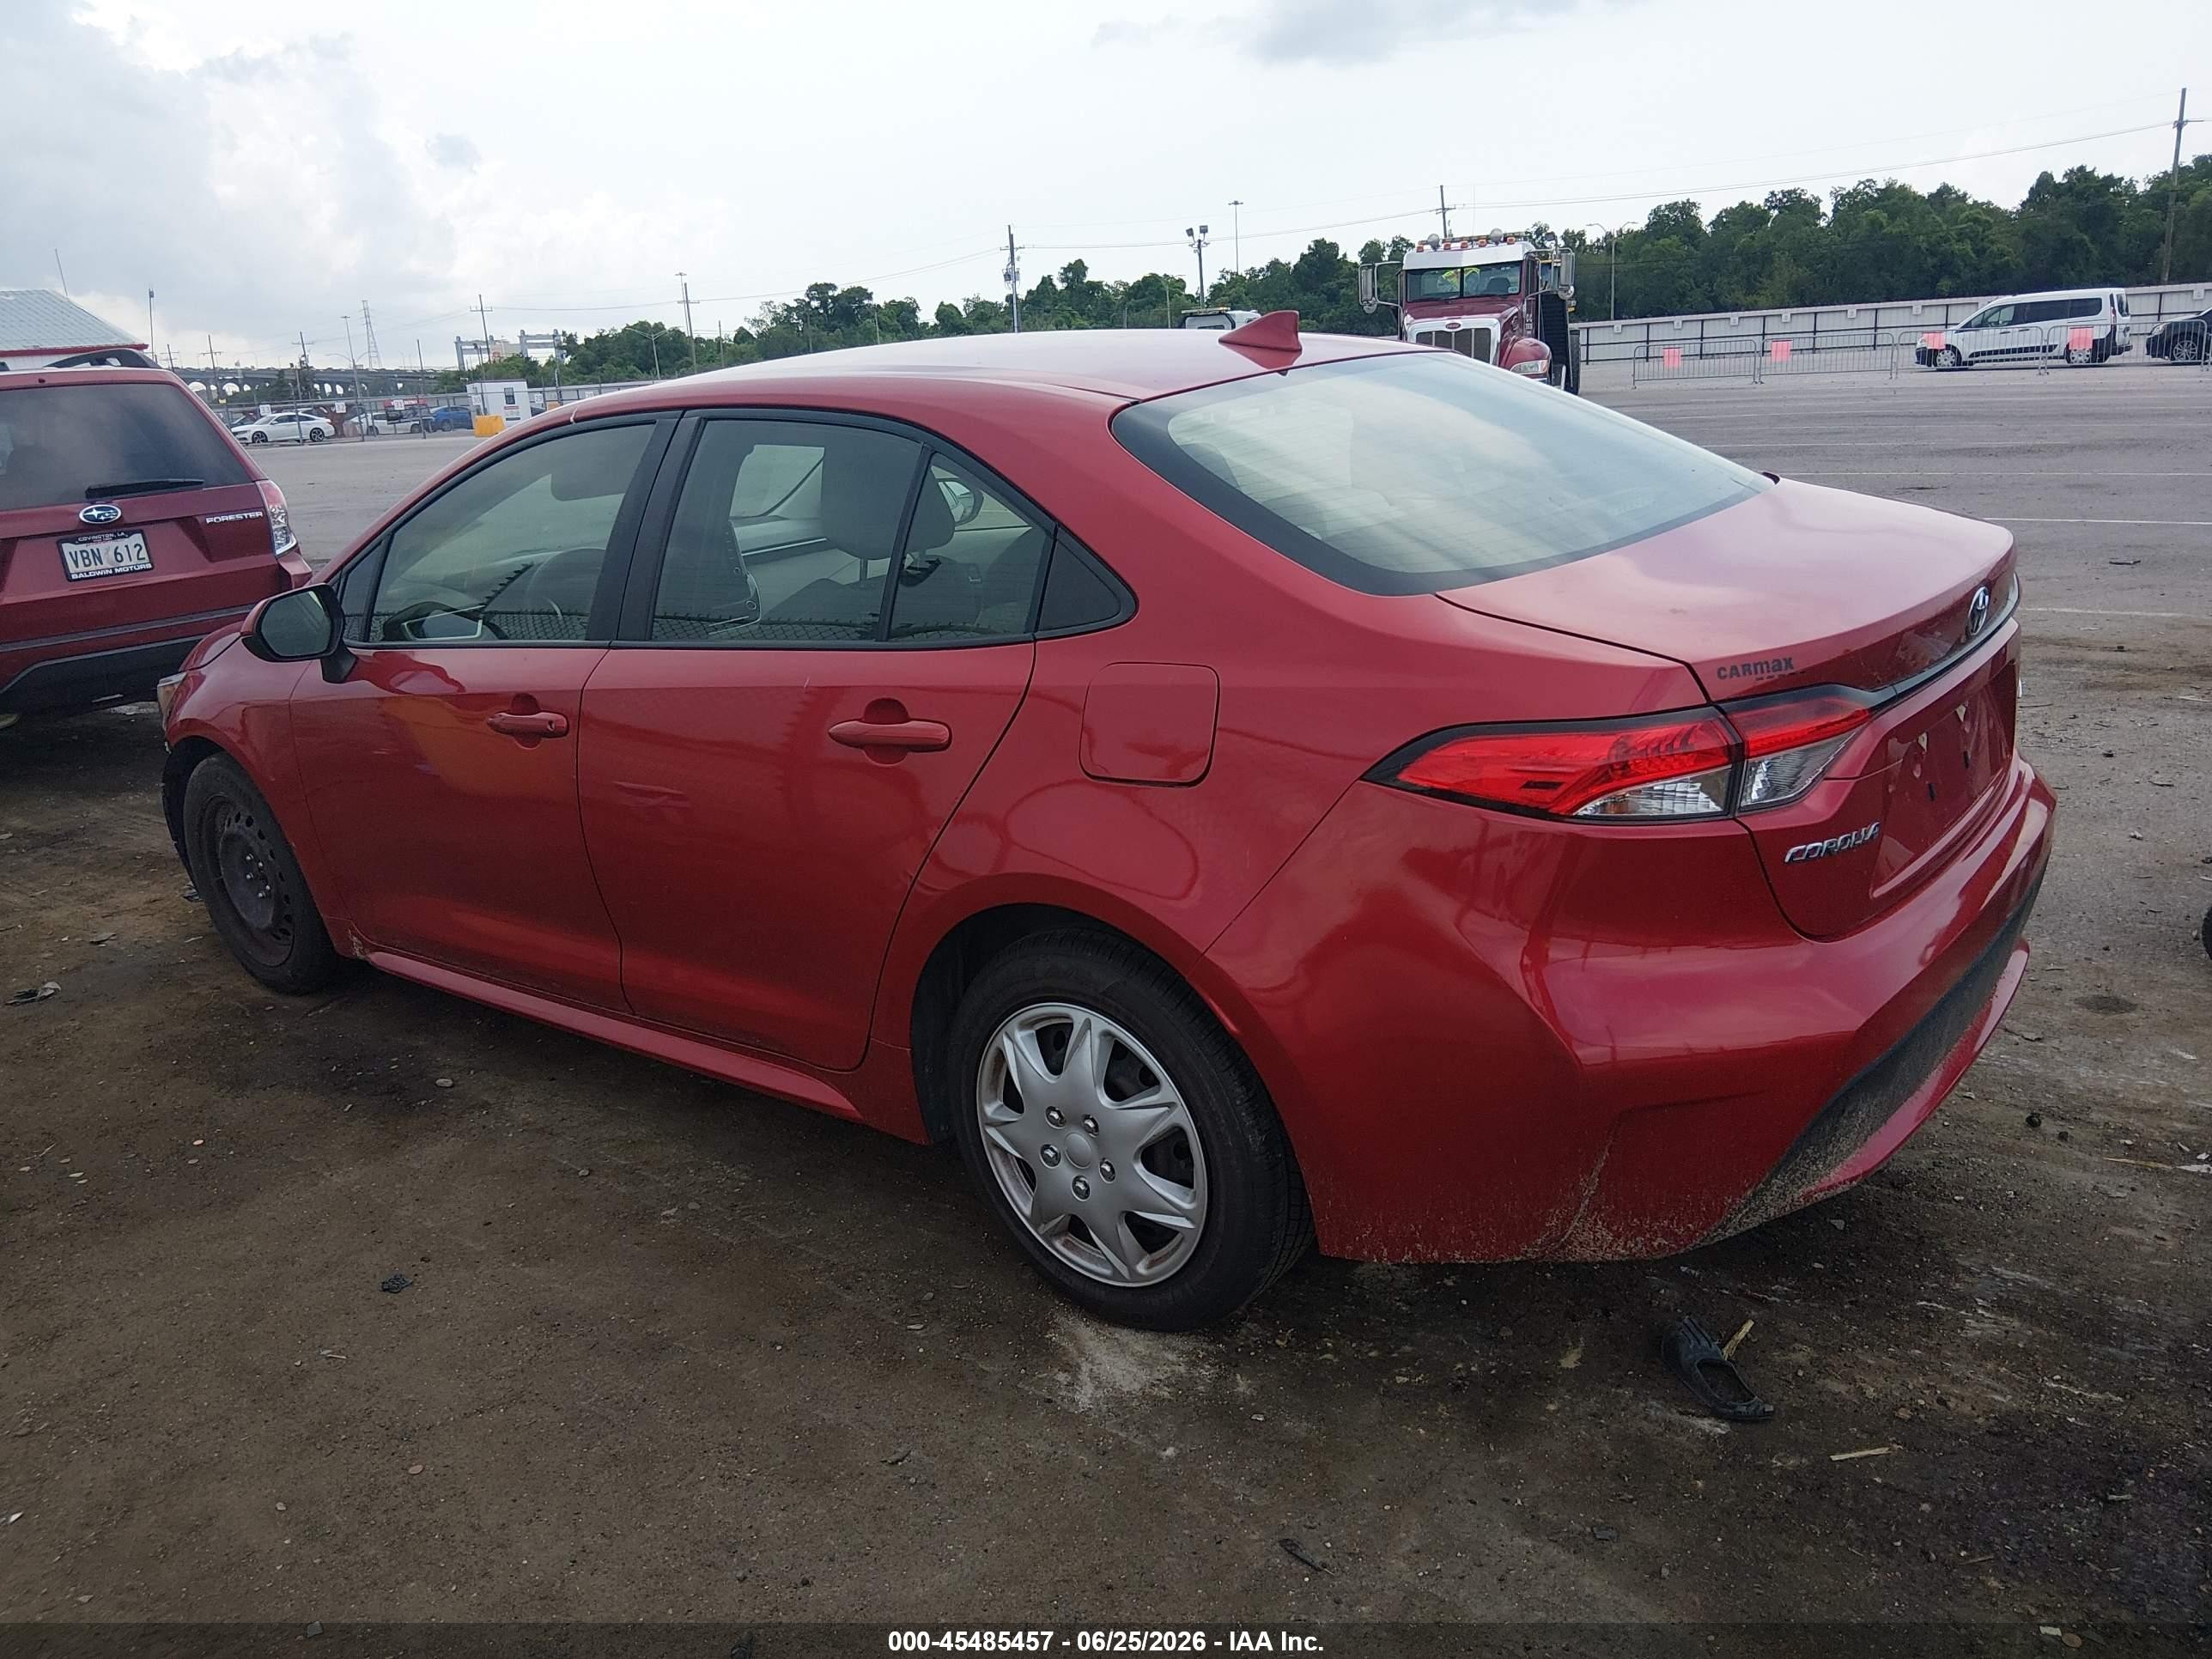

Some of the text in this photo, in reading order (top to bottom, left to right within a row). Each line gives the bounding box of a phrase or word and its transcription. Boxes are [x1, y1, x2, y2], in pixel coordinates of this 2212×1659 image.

[206, 512, 264, 524] FORESTER
[69, 543, 146, 568] VBN 612
[70, 568, 113, 580] BALDWIN
[1784, 822, 1881, 863] COROLLA
